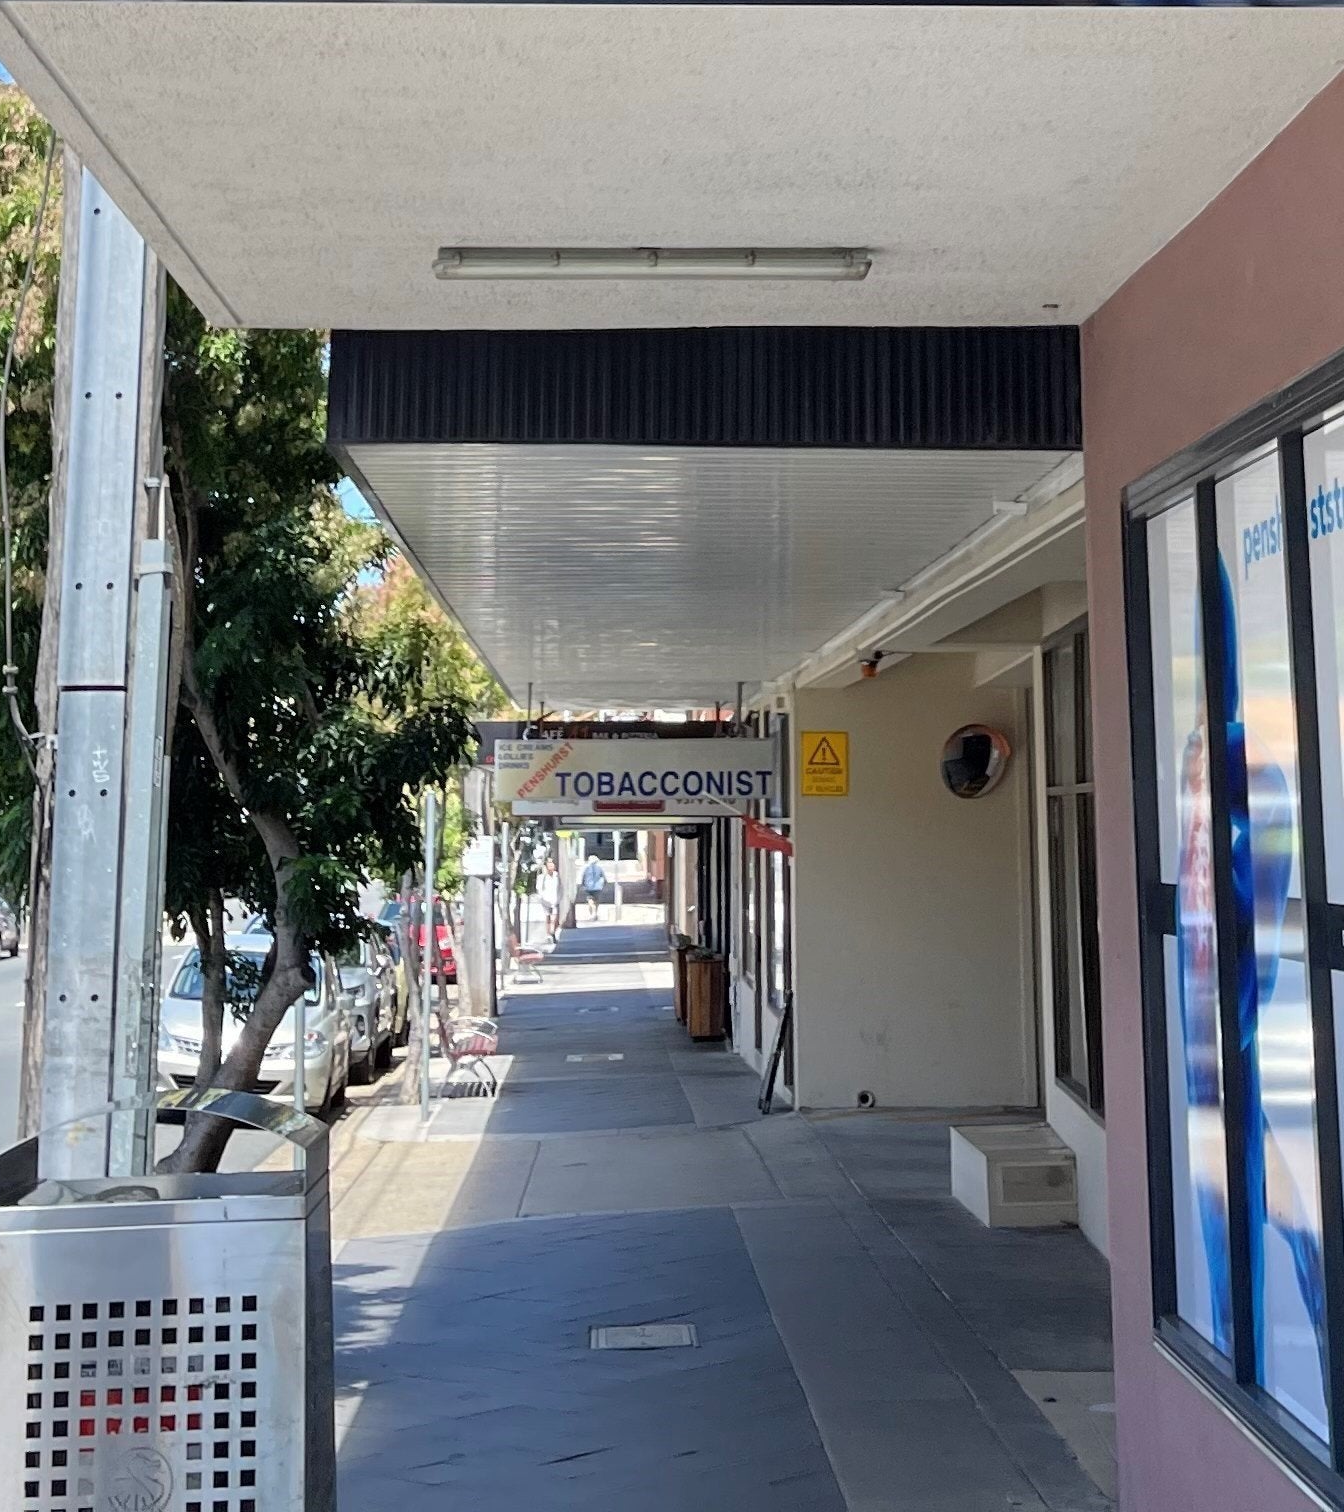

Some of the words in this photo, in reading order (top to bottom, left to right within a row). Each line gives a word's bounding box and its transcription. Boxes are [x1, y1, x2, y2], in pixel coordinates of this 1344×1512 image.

[498, 753, 534, 761] LOLLIES
[516, 741, 575, 798] PENSHURST
[555, 770, 773, 797] TOBACCONIST
